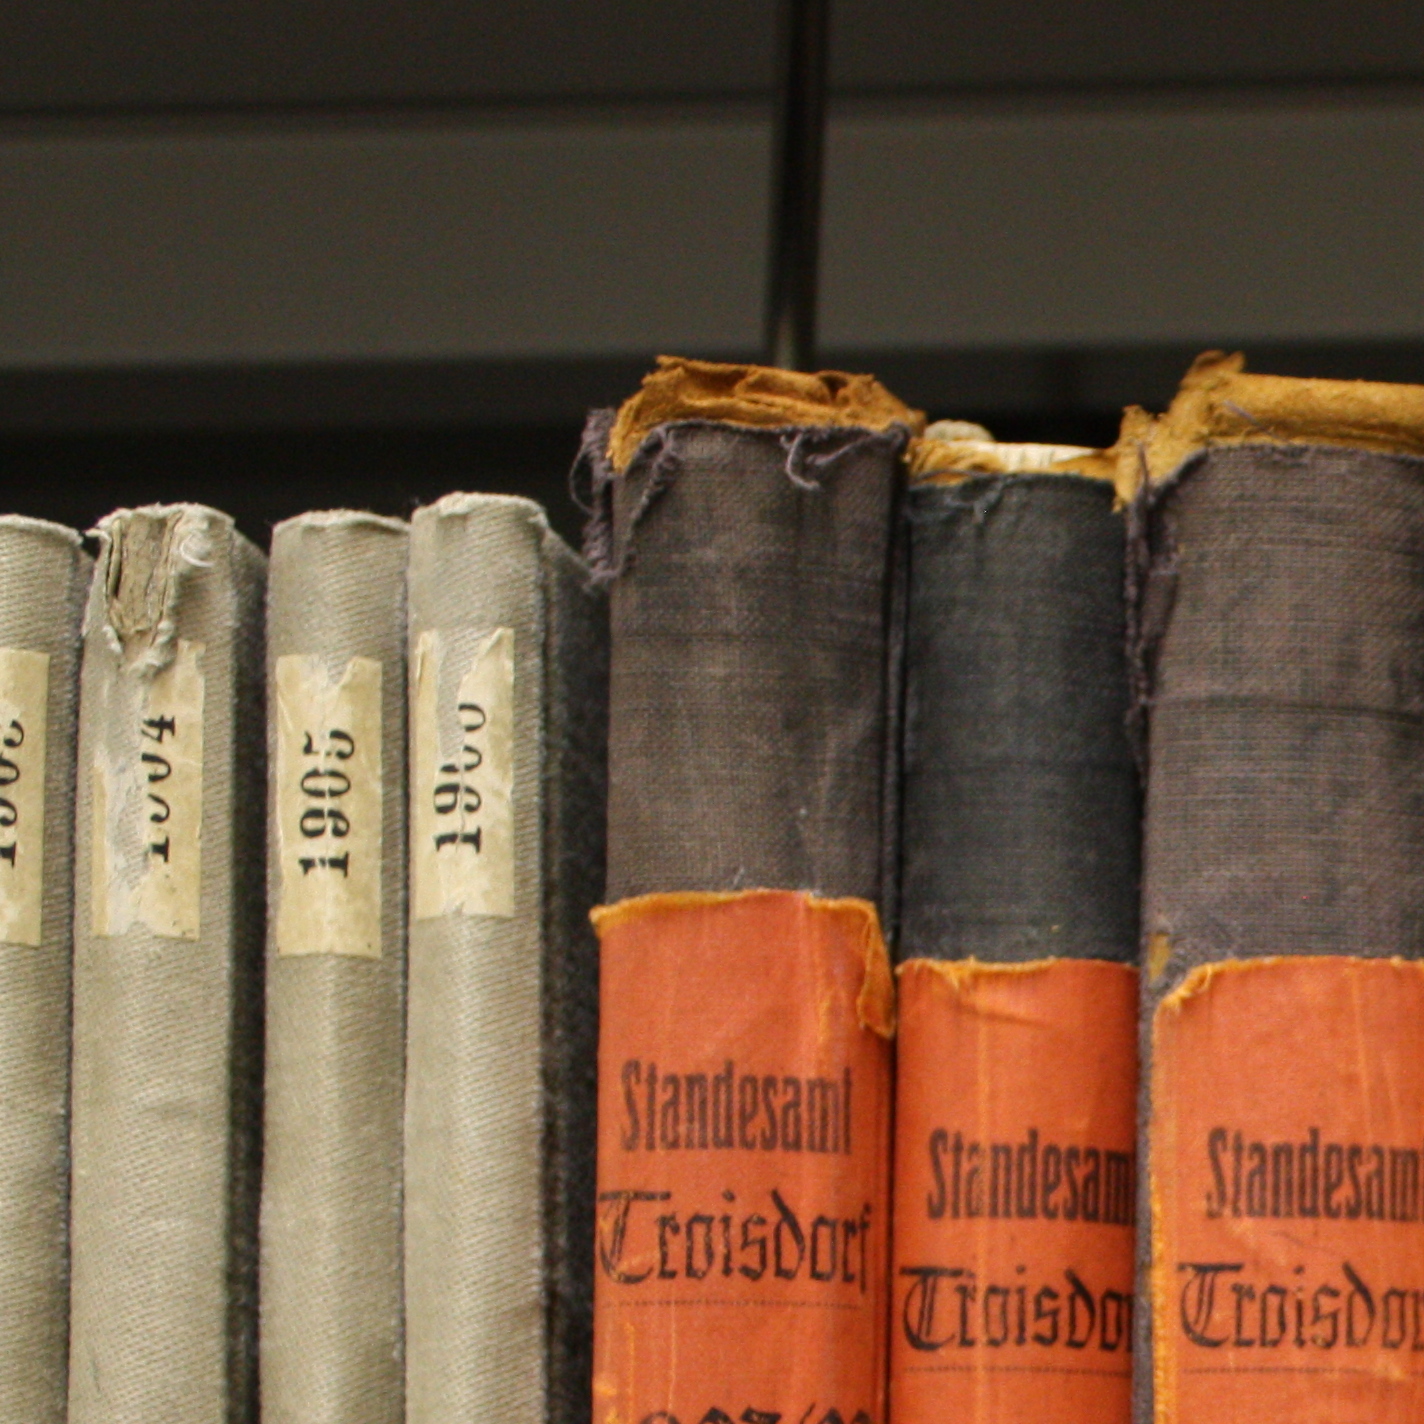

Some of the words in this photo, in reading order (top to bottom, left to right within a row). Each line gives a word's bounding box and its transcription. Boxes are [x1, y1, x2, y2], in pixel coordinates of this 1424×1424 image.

[299, 726, 356, 879] 1905
[621, 1059, 851, 1155] Standesamt
[600, 1188, 871, 1295] Troisdorf
